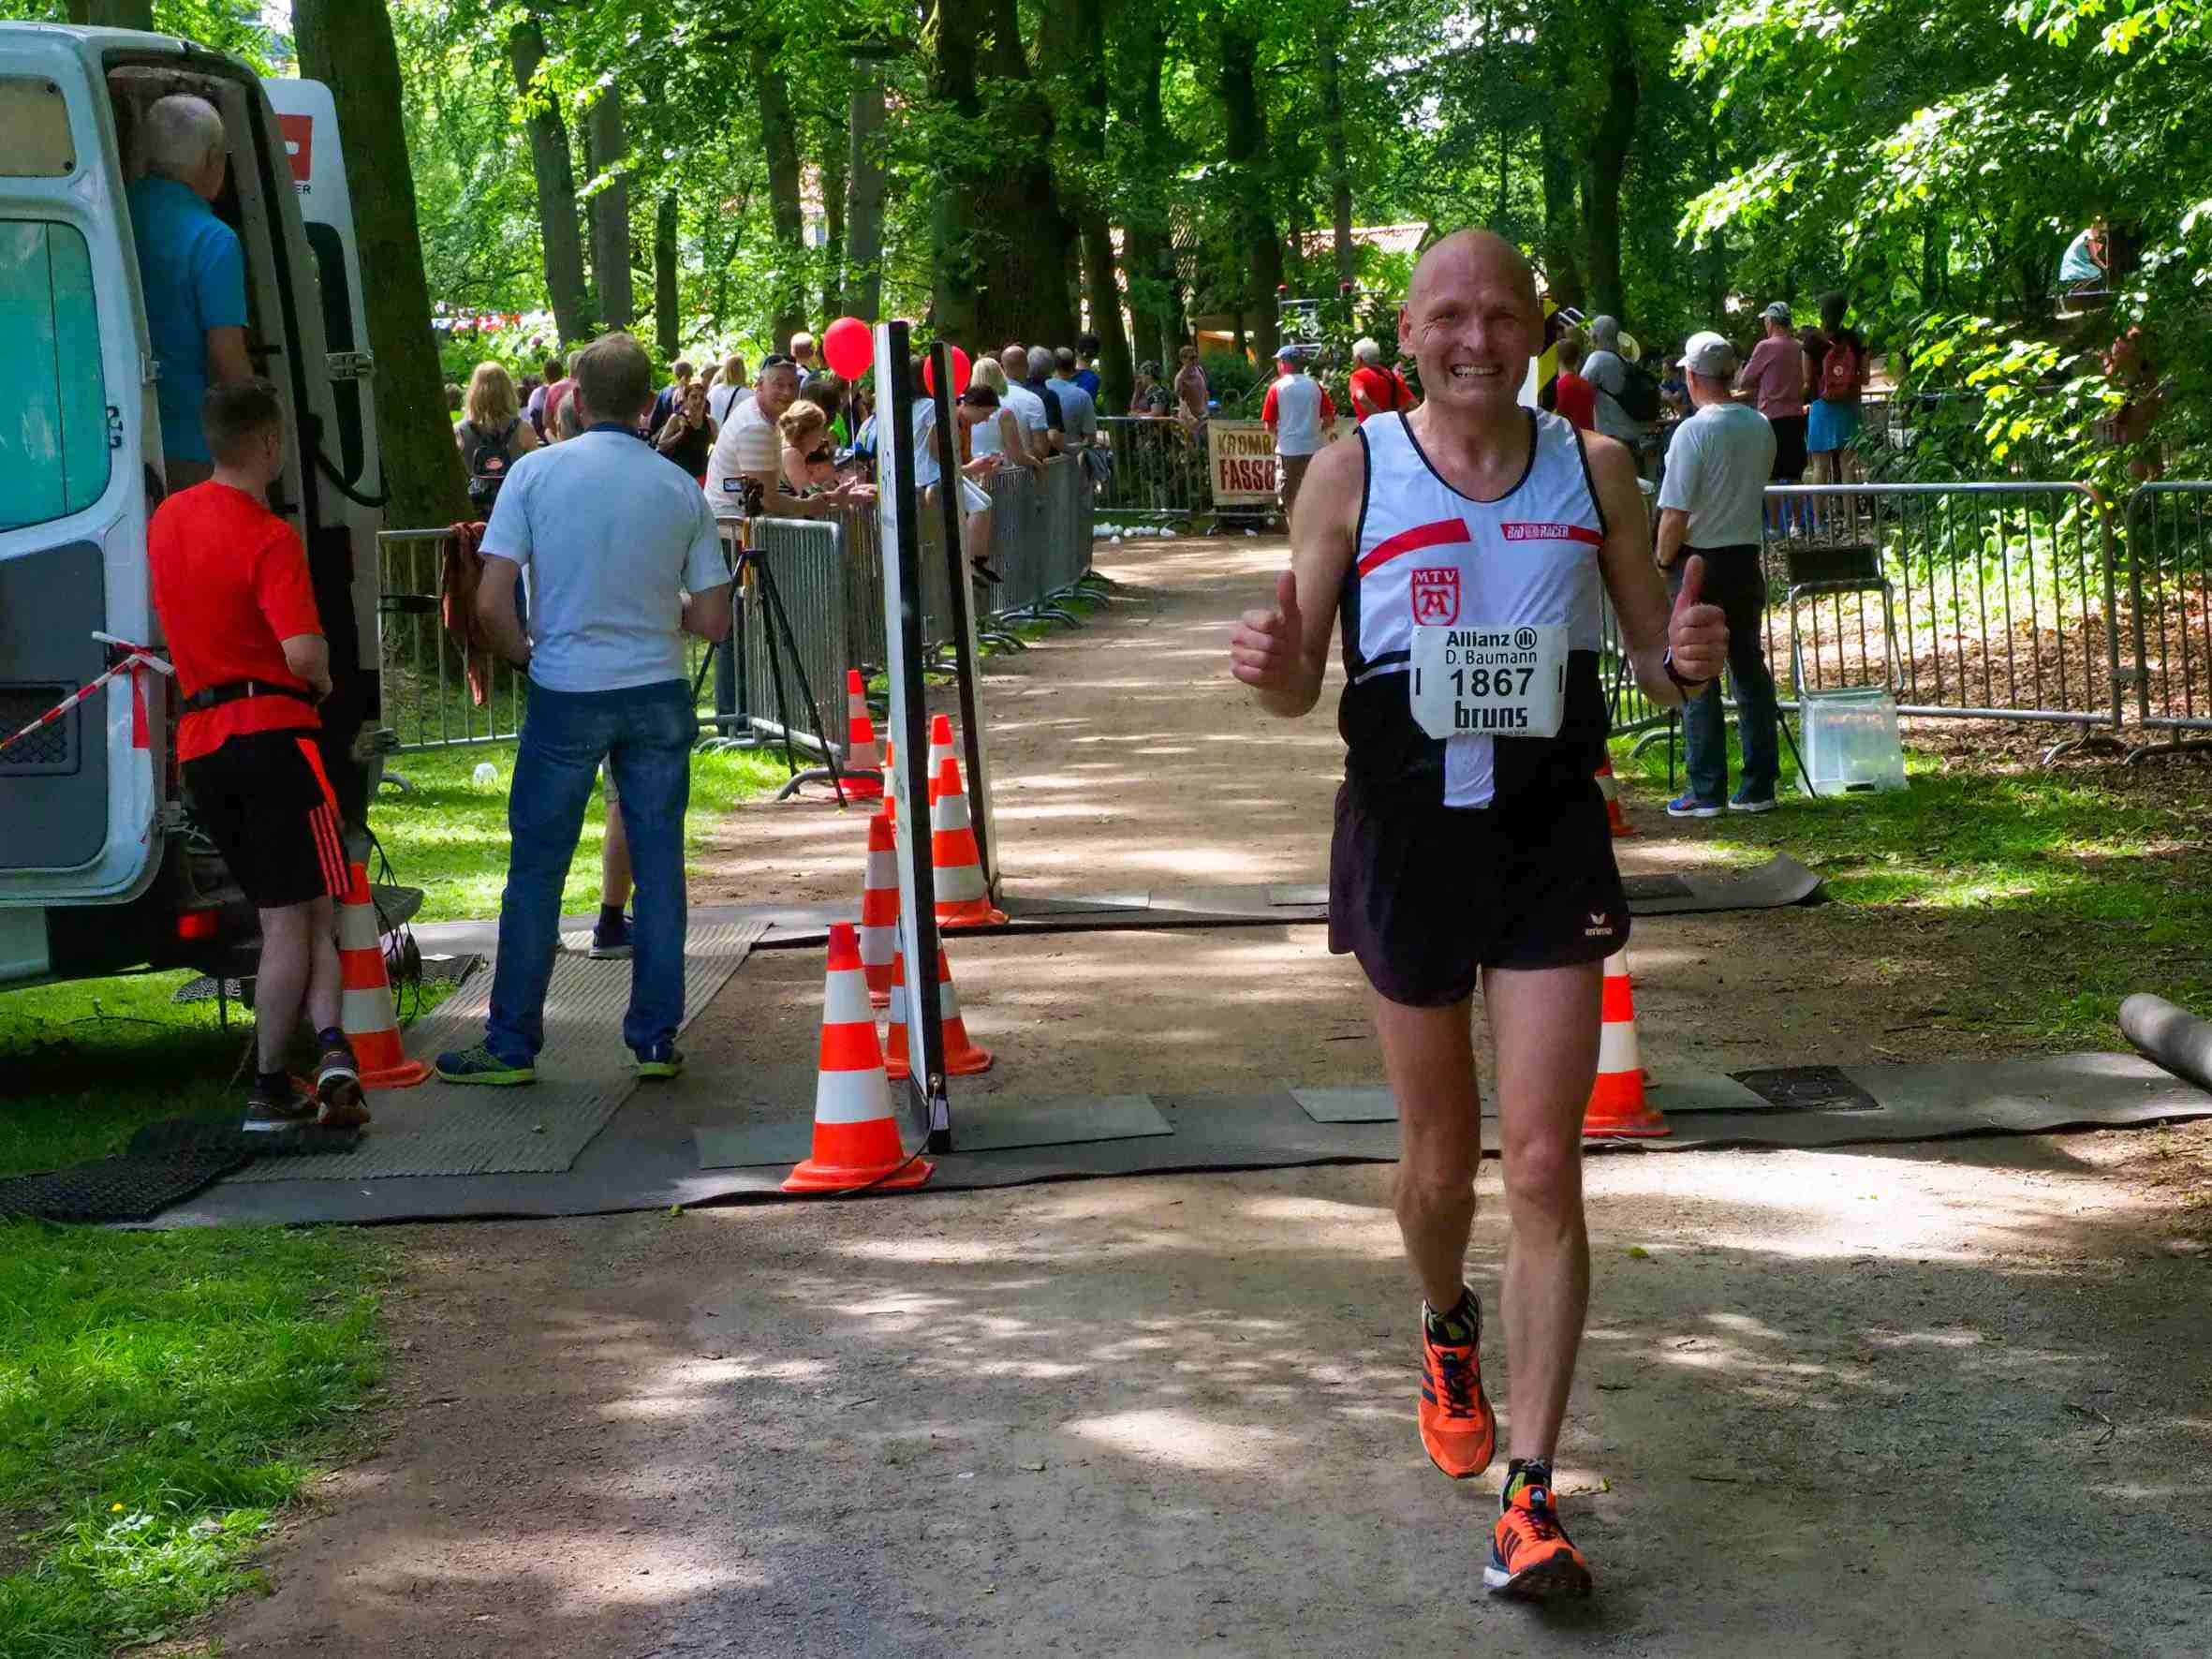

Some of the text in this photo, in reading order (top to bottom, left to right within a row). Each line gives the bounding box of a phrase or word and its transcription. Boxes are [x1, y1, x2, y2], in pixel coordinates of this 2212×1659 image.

[1415, 570, 1455, 584] MTV
[1445, 631, 1511, 647] Allianz
[1445, 649, 1537, 665] D. Baumann
[1450, 668, 1535, 697] 1867
[1454, 700, 1528, 729] bruns
